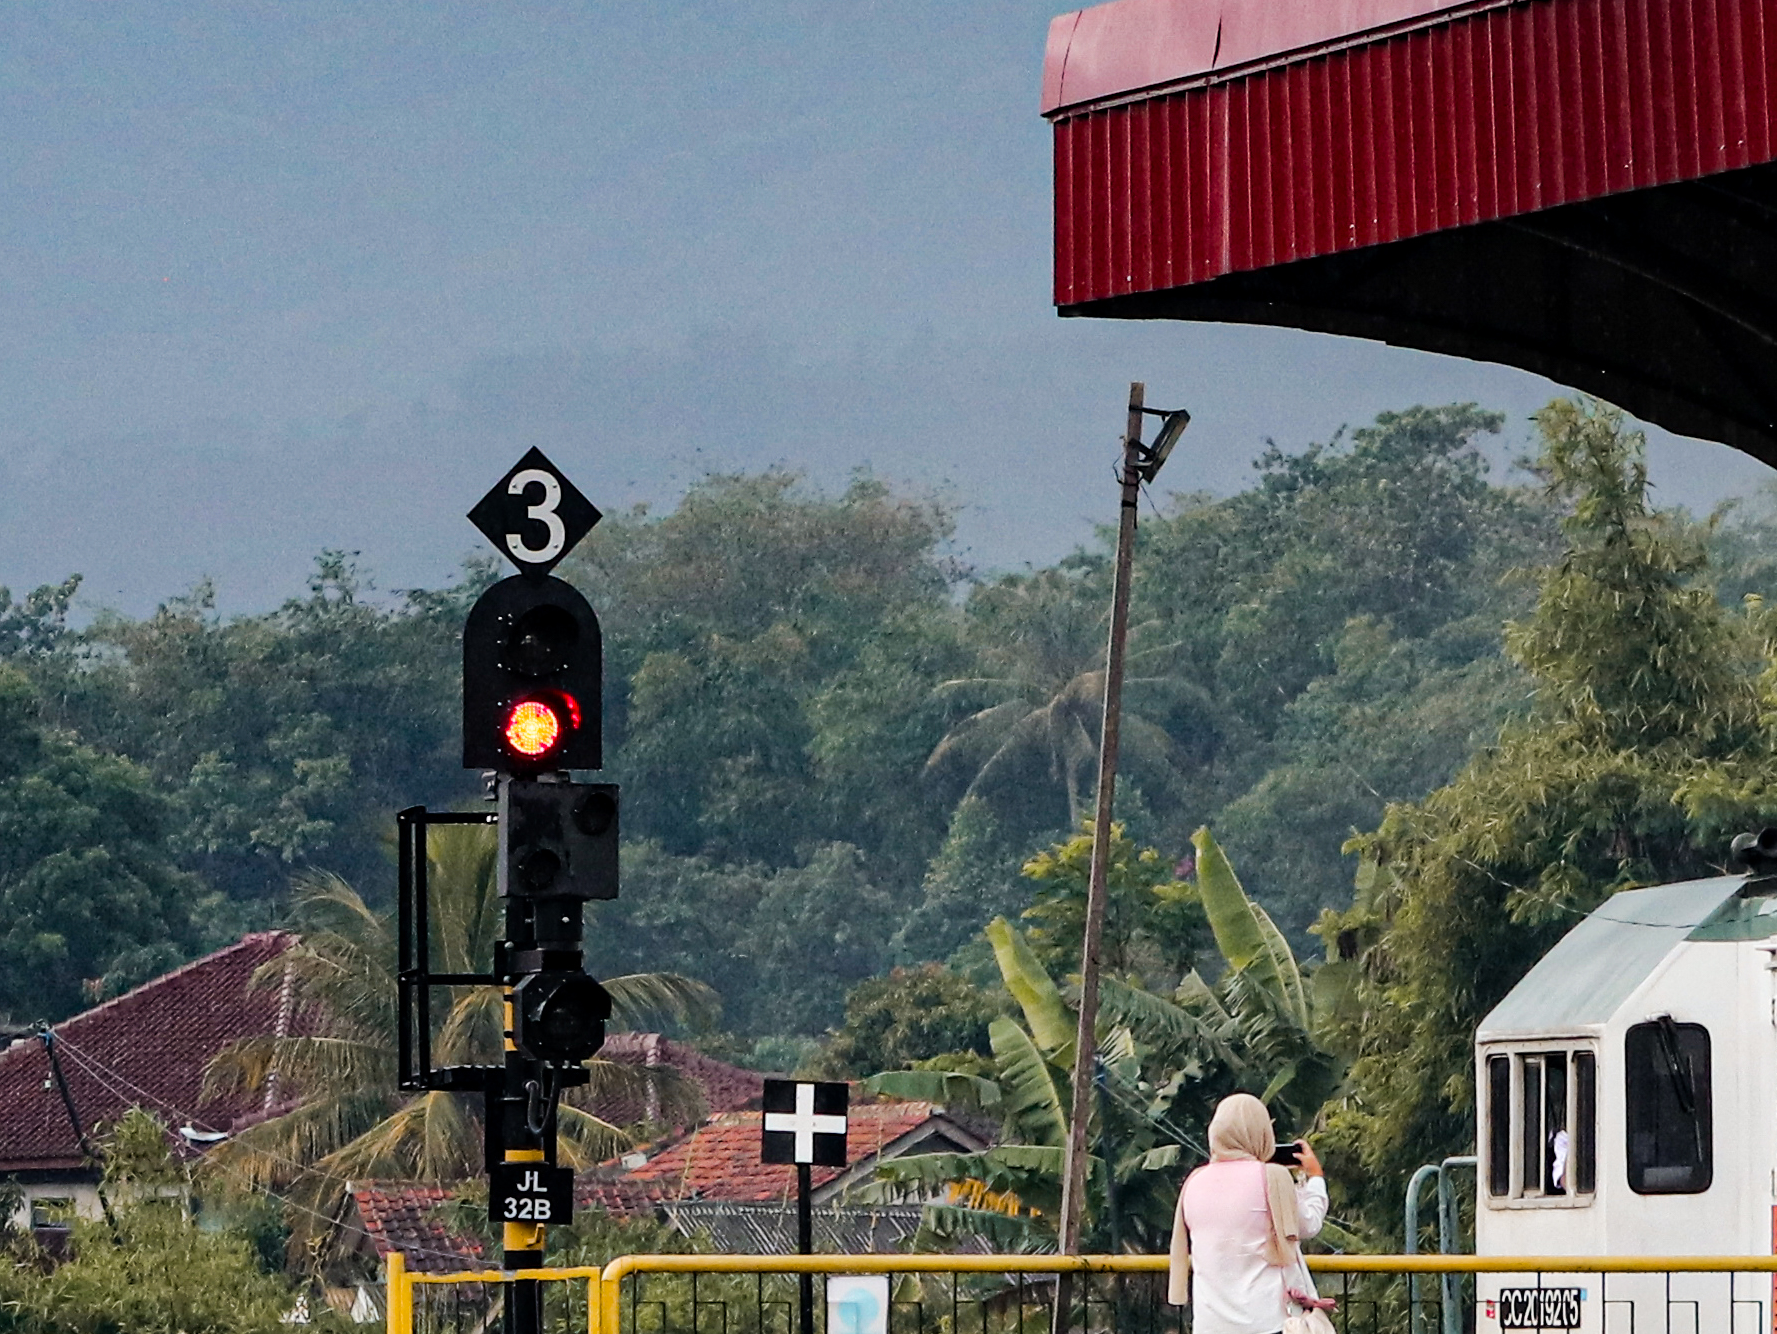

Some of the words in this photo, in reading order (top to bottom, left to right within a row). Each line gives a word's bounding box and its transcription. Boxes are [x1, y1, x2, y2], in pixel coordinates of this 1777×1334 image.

[505, 468, 566, 564] 3
[517, 1170, 548, 1192] JL
[503, 1196, 552, 1220] 32B
